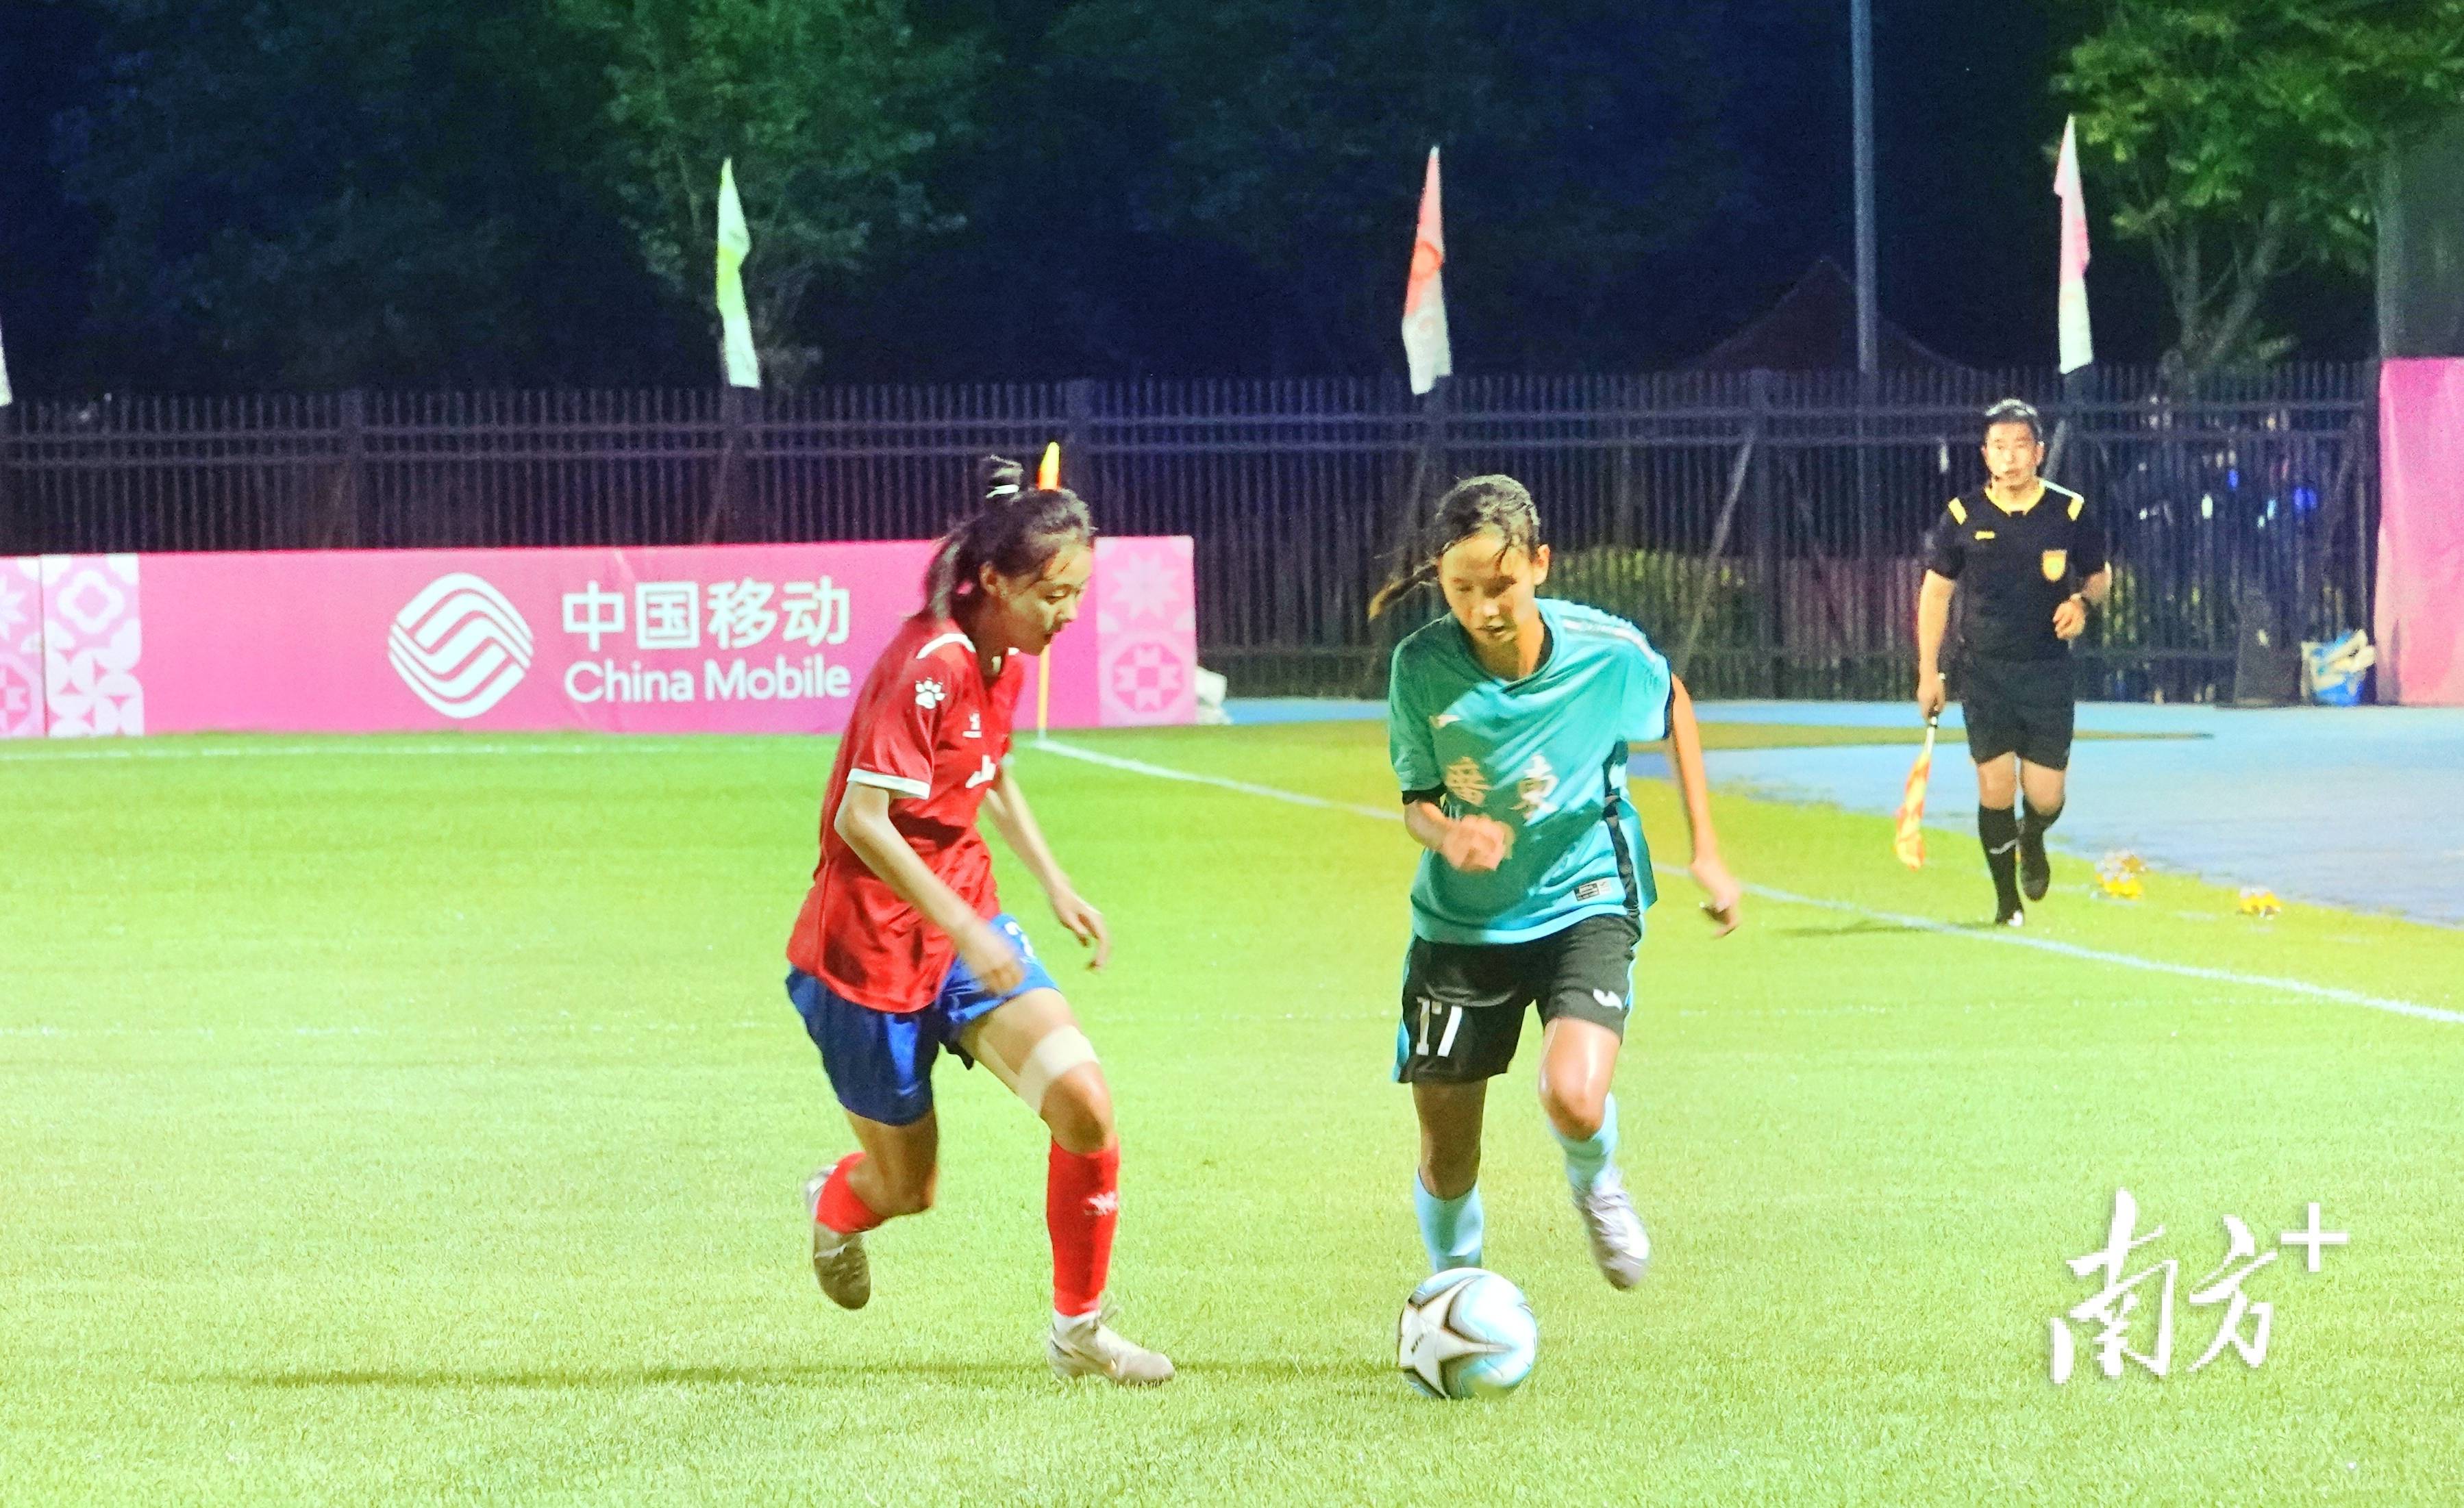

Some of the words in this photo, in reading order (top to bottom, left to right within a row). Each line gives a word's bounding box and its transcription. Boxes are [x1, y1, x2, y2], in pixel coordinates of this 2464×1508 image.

[562, 575, 851, 651] 中国移动
[564, 654, 695, 703] China
[705, 653, 851, 701] Mobile
[1415, 996, 1463, 1058] 17
